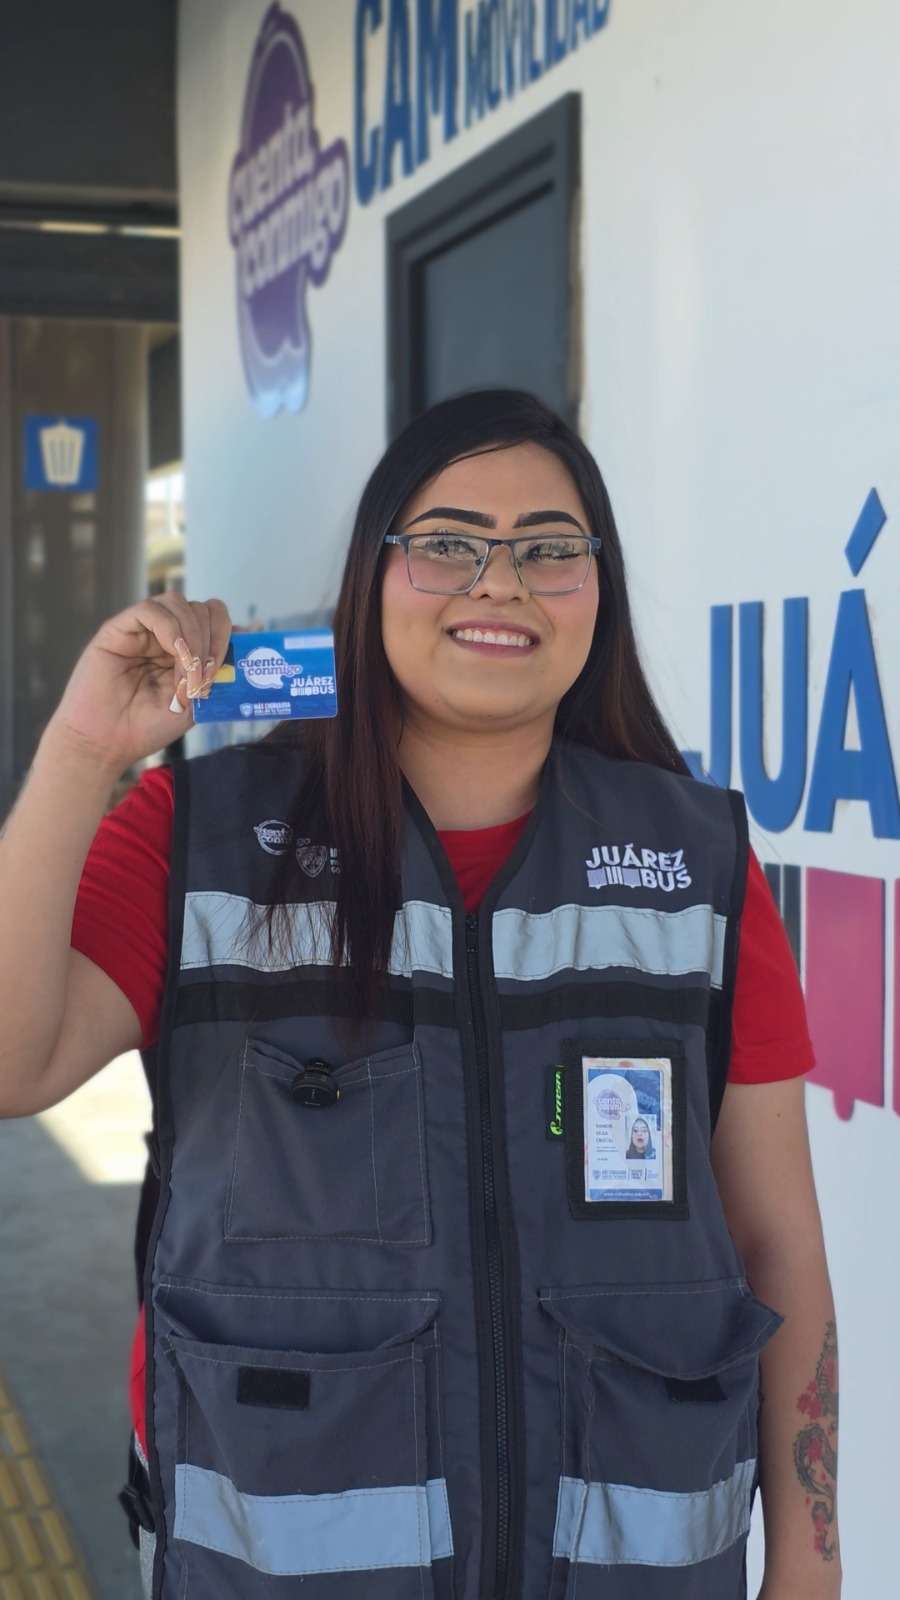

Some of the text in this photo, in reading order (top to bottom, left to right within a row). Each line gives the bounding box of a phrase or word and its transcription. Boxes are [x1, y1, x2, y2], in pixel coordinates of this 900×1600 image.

[355, 0, 610, 207] CAM MOVILID
[239, 656, 284, 667] cuenta
[248, 664, 301, 676] conmigo
[290, 676, 333, 687] JUÁREZ
[312, 685, 335, 695] BUS
[585, 842, 686, 872] JUÁREZ
[640, 868, 692, 892] BUS
